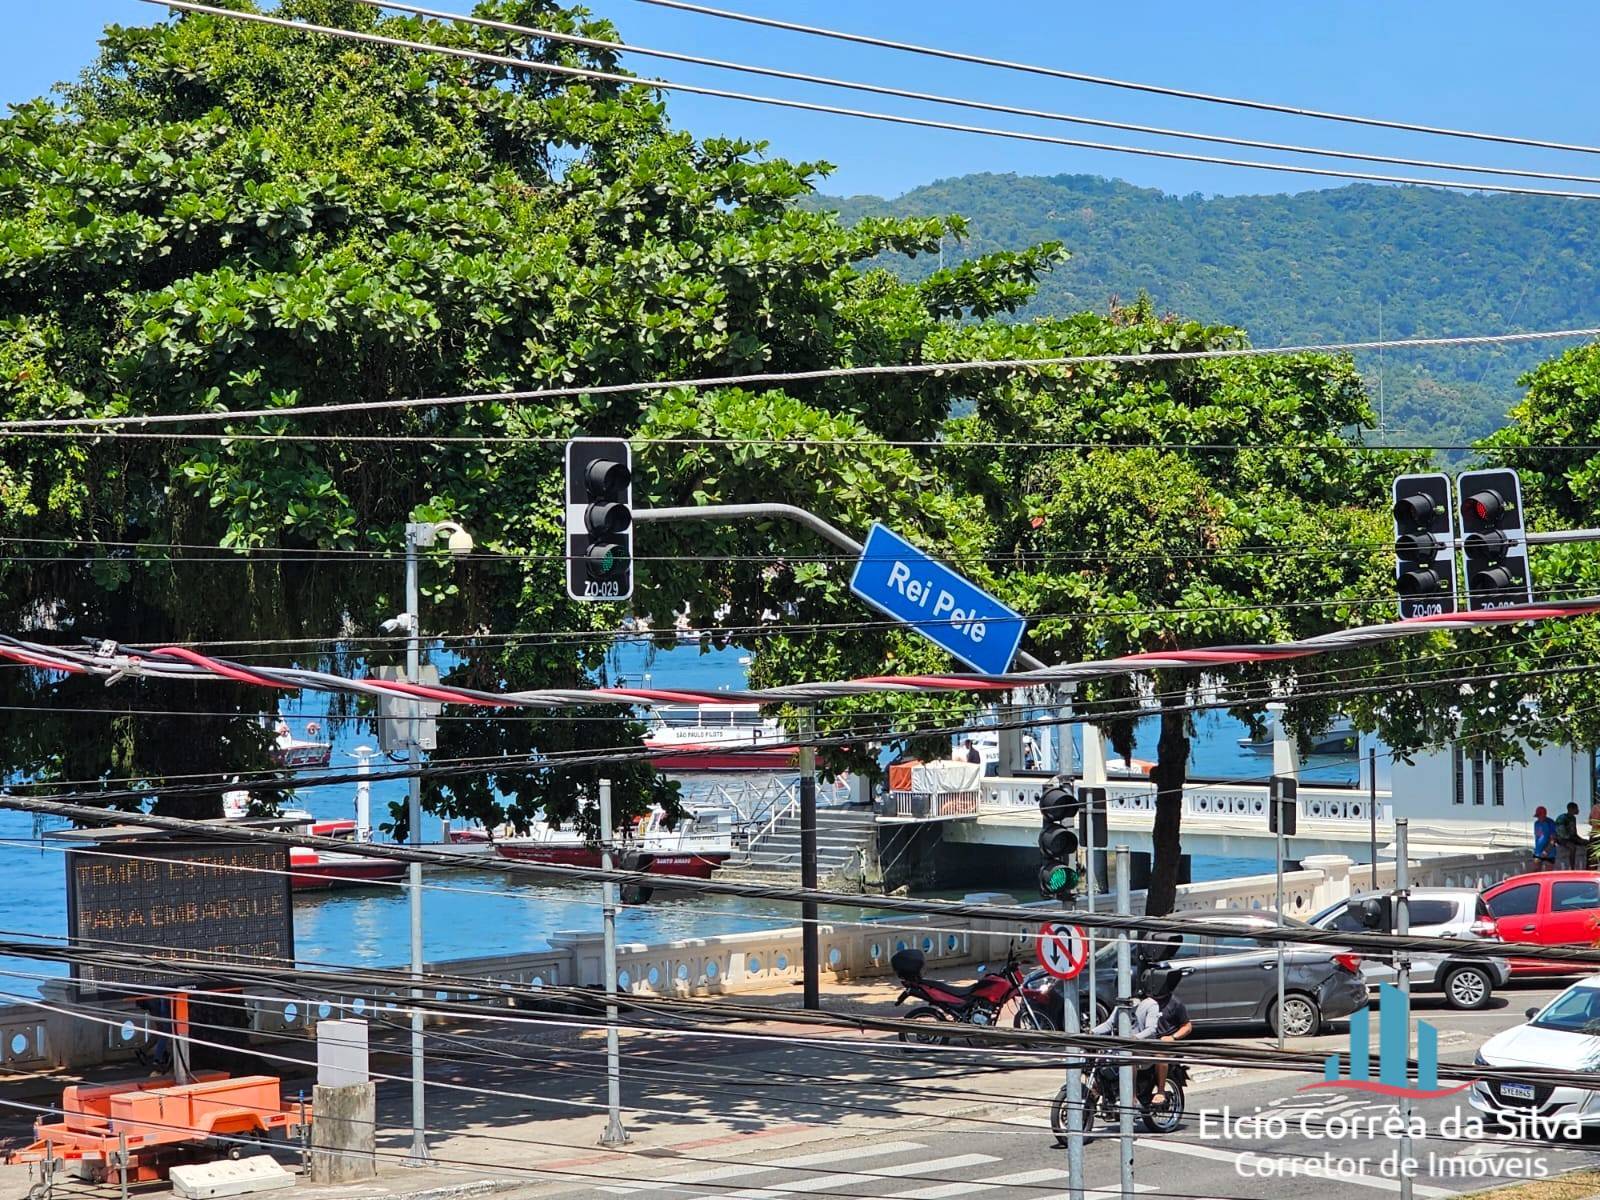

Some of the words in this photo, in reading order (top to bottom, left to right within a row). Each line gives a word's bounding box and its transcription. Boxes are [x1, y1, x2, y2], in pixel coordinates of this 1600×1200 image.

[584, 580, 619, 596] ZO-029
[886, 560, 933, 608] Rei
[932, 589, 986, 643] Pelé
[1412, 603, 1442, 618] ZO-029
[76, 858, 157, 886] TEMPO
[80, 907, 145, 930] PARA
